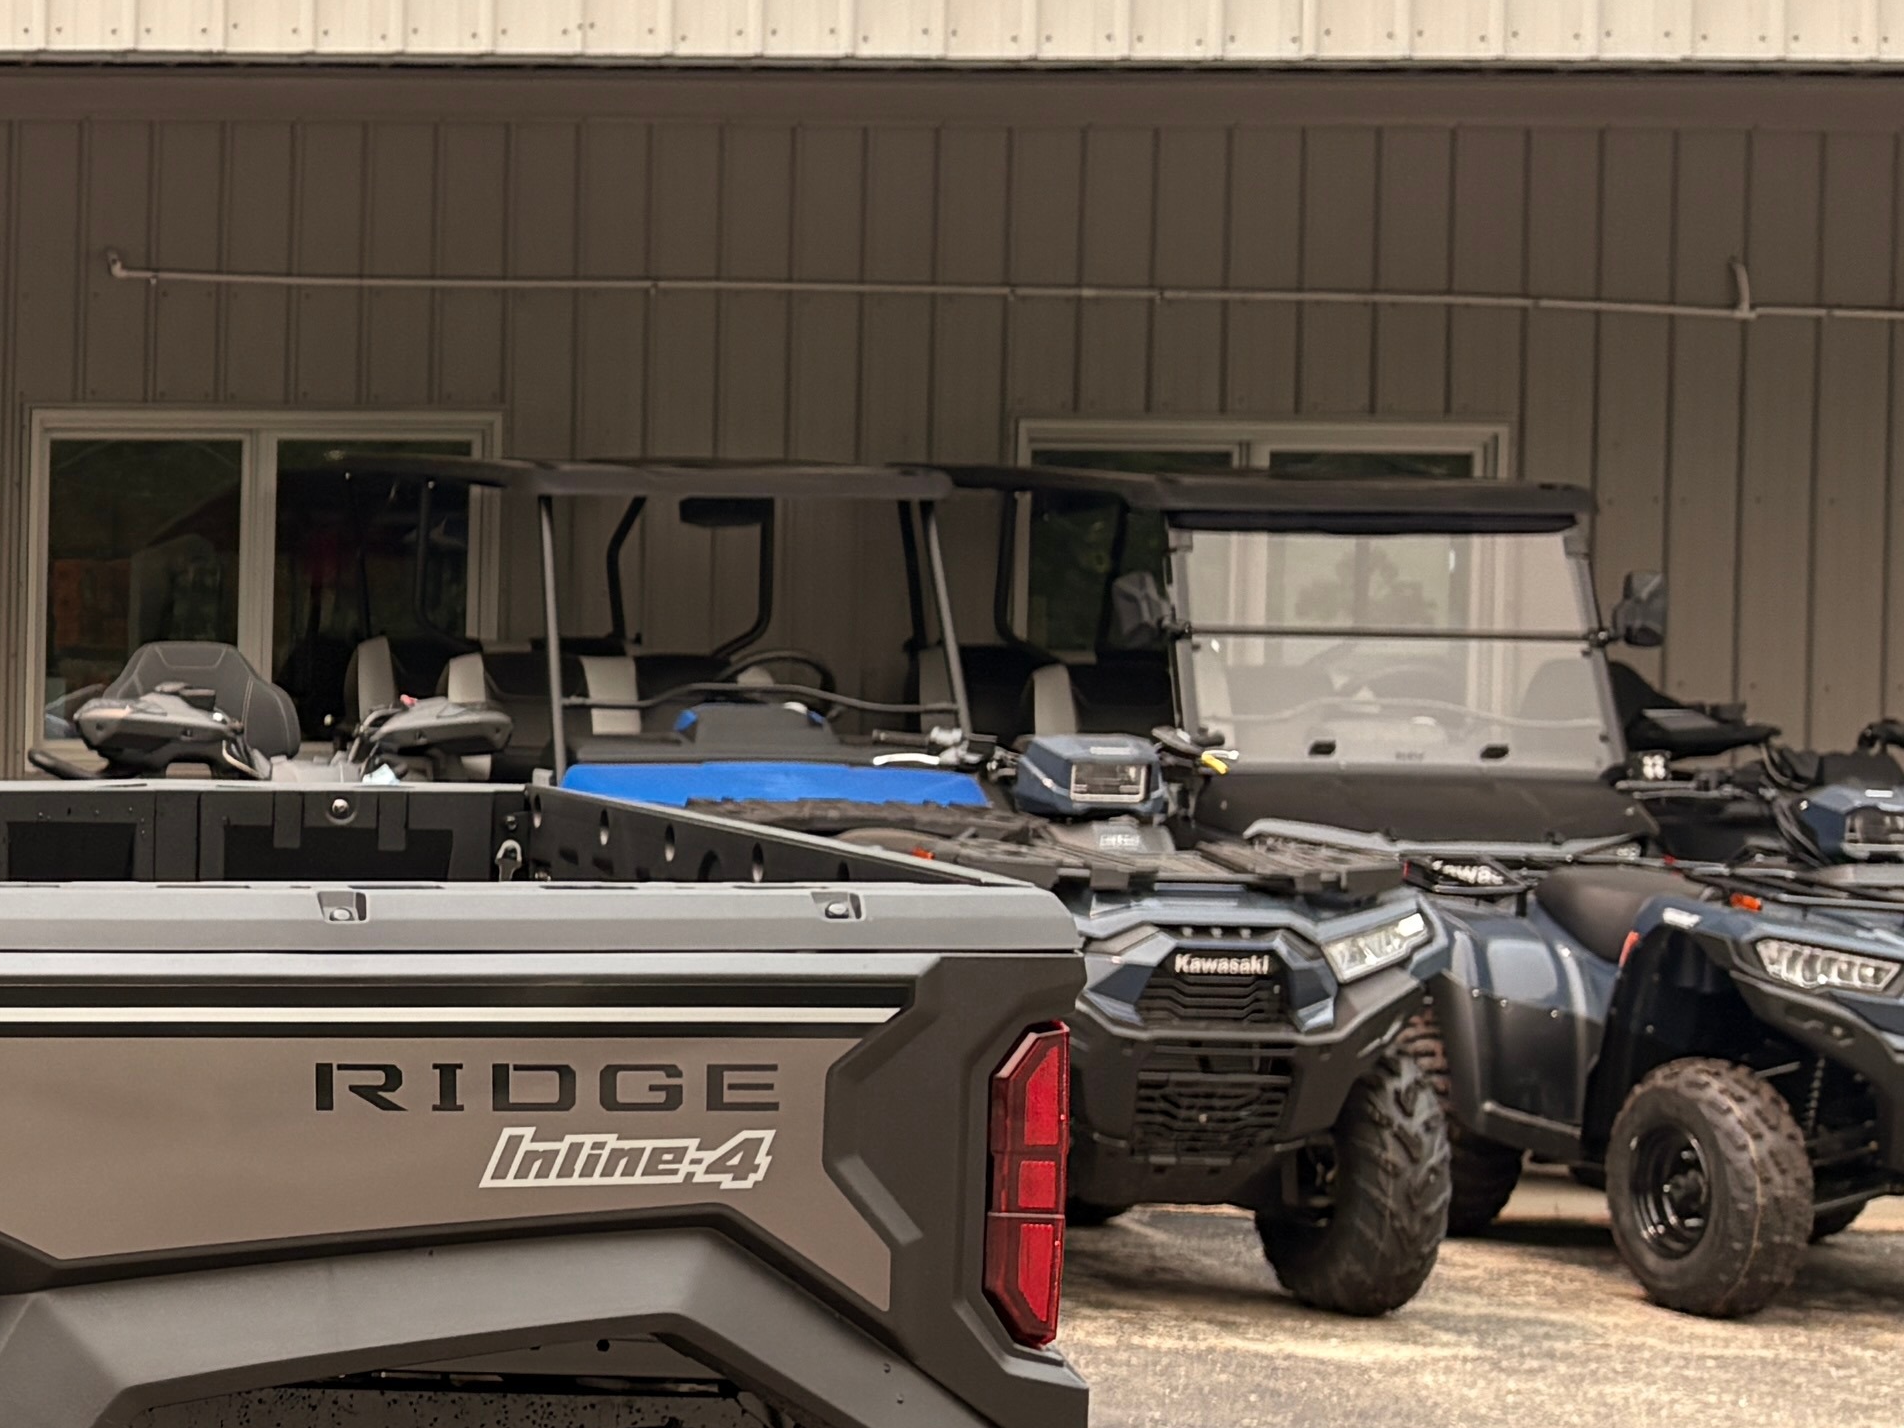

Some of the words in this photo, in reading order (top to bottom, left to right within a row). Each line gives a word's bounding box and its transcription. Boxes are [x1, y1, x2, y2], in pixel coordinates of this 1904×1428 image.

[1174, 953, 1270, 975] Kawasaki
[314, 1062, 780, 1112] RIDGE
[478, 1125, 777, 1190] Inline-4
